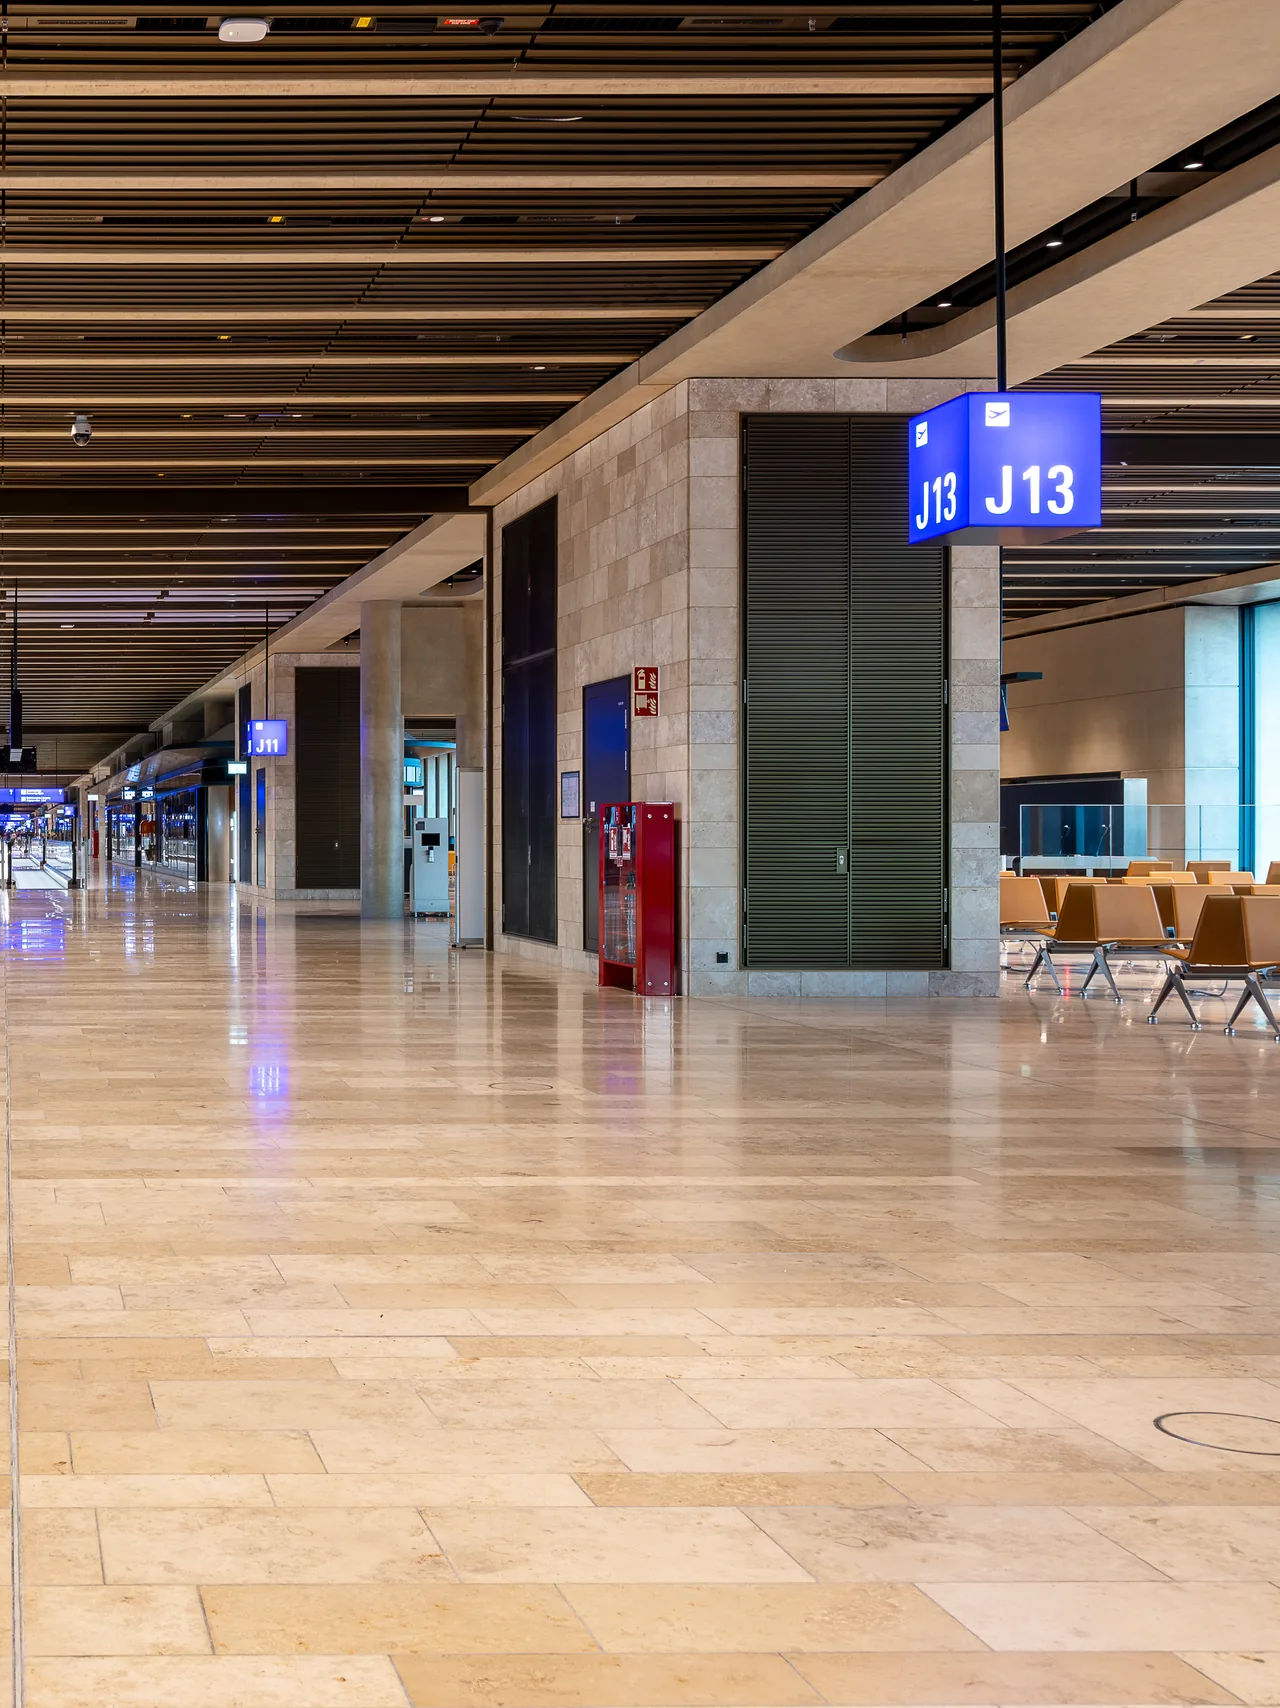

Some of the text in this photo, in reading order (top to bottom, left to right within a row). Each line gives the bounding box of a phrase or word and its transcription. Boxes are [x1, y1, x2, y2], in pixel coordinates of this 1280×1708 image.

[915, 471, 957, 530] J13
[985, 464, 1075, 515] J13
[255, 738, 279, 753] J11
